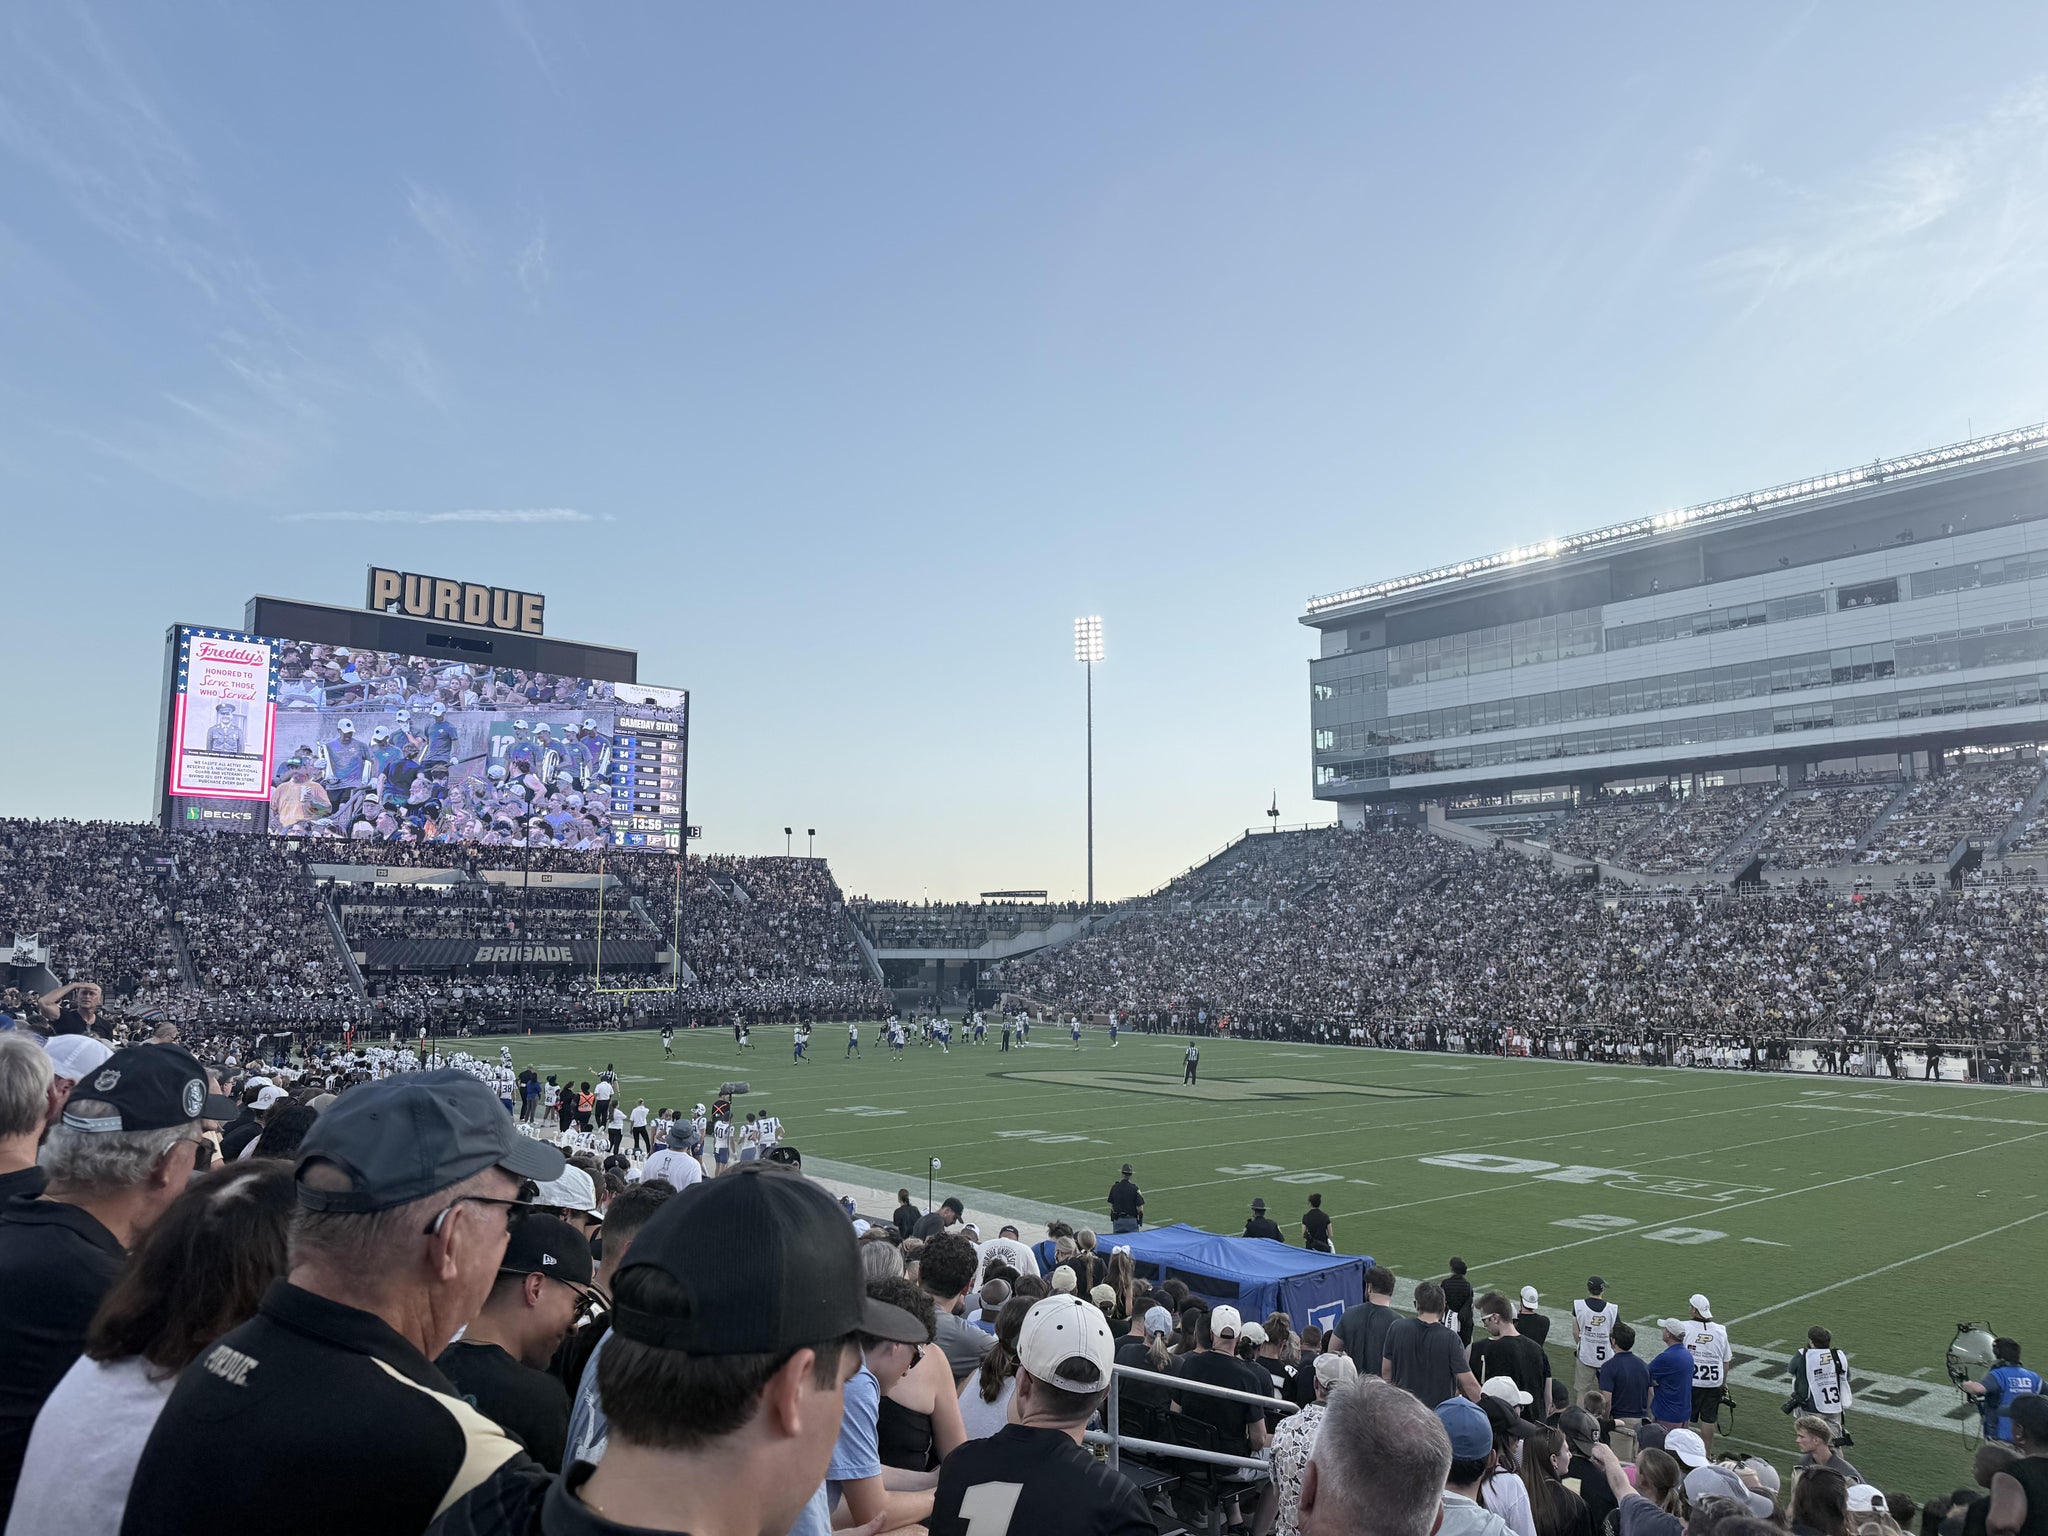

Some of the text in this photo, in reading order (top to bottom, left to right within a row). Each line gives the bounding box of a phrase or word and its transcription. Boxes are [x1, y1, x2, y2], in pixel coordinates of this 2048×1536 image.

[372, 568, 545, 635] PURDUE
[196, 642, 264, 667] Freddy's
[205, 667, 242, 678] HONORED
[199, 675, 255, 690] Serve THOSE
[199, 688, 257, 701] WHO Served
[620, 718, 678, 732] GAMEDAY STATS
[620, 751, 629, 759] 54
[203, 810, 252, 820] BECK'S
[632, 818, 662, 831] 13:56
[690, 826, 700, 837] 13
[615, 831, 625, 845] 3
[665, 834, 679, 848] 10
[474, 946, 574, 962] BRIGADE
[502, 1084, 512, 1093] 38
[763, 1122, 773, 1134] 31
[1215, 1163, 1345, 1184] 30
[1547, 1214, 1729, 1245] 20
[1596, 1346, 1606, 1361] 5
[1692, 1365, 1719, 1381] 225
[1821, 1386, 1841, 1405] 13
[958, 1481, 1024, 1536] 1
